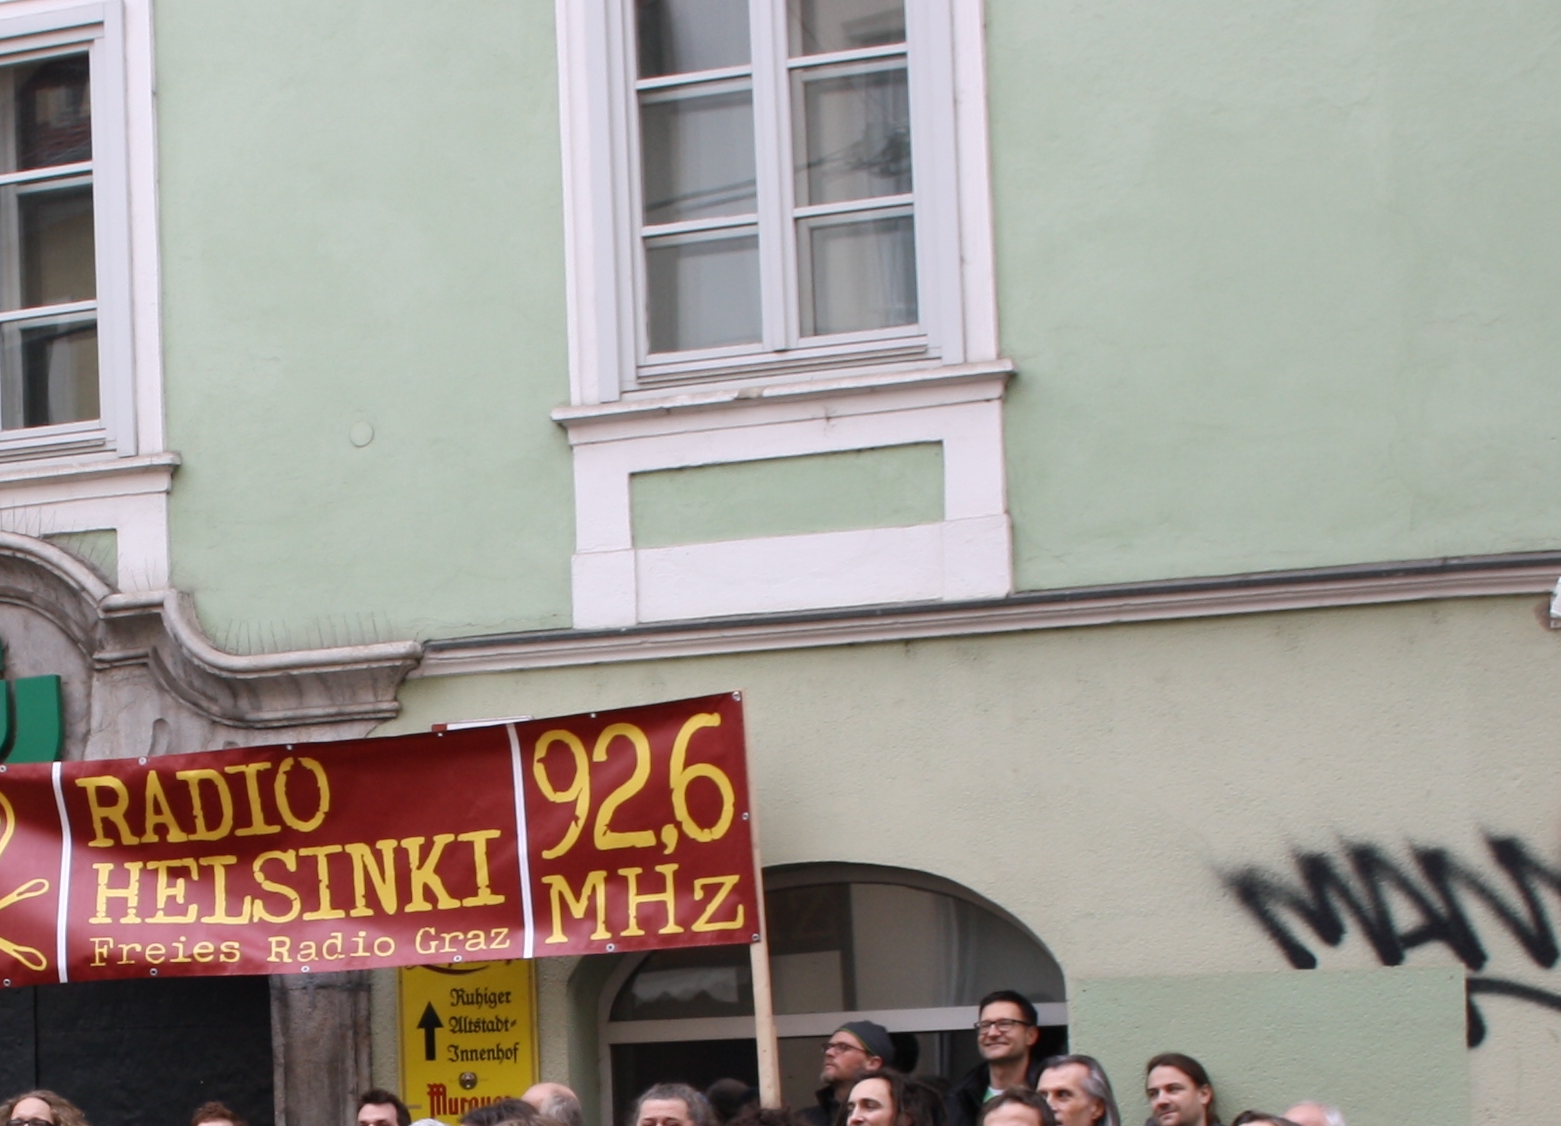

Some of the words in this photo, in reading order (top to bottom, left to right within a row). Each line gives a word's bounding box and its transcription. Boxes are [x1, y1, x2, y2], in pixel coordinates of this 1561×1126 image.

[75, 756, 330, 848] RADIO
[533, 712, 735, 859] 92,6
[89, 829, 505, 925] HELSINKI
[542, 863, 745, 944] MHz
[89, 935, 241, 967] Freies
[267, 930, 395, 964] Radio
[415, 926, 510, 955] Graz
[450, 987, 512, 1009] Ruhiger
[447, 1042, 520, 1064] Innenhof
